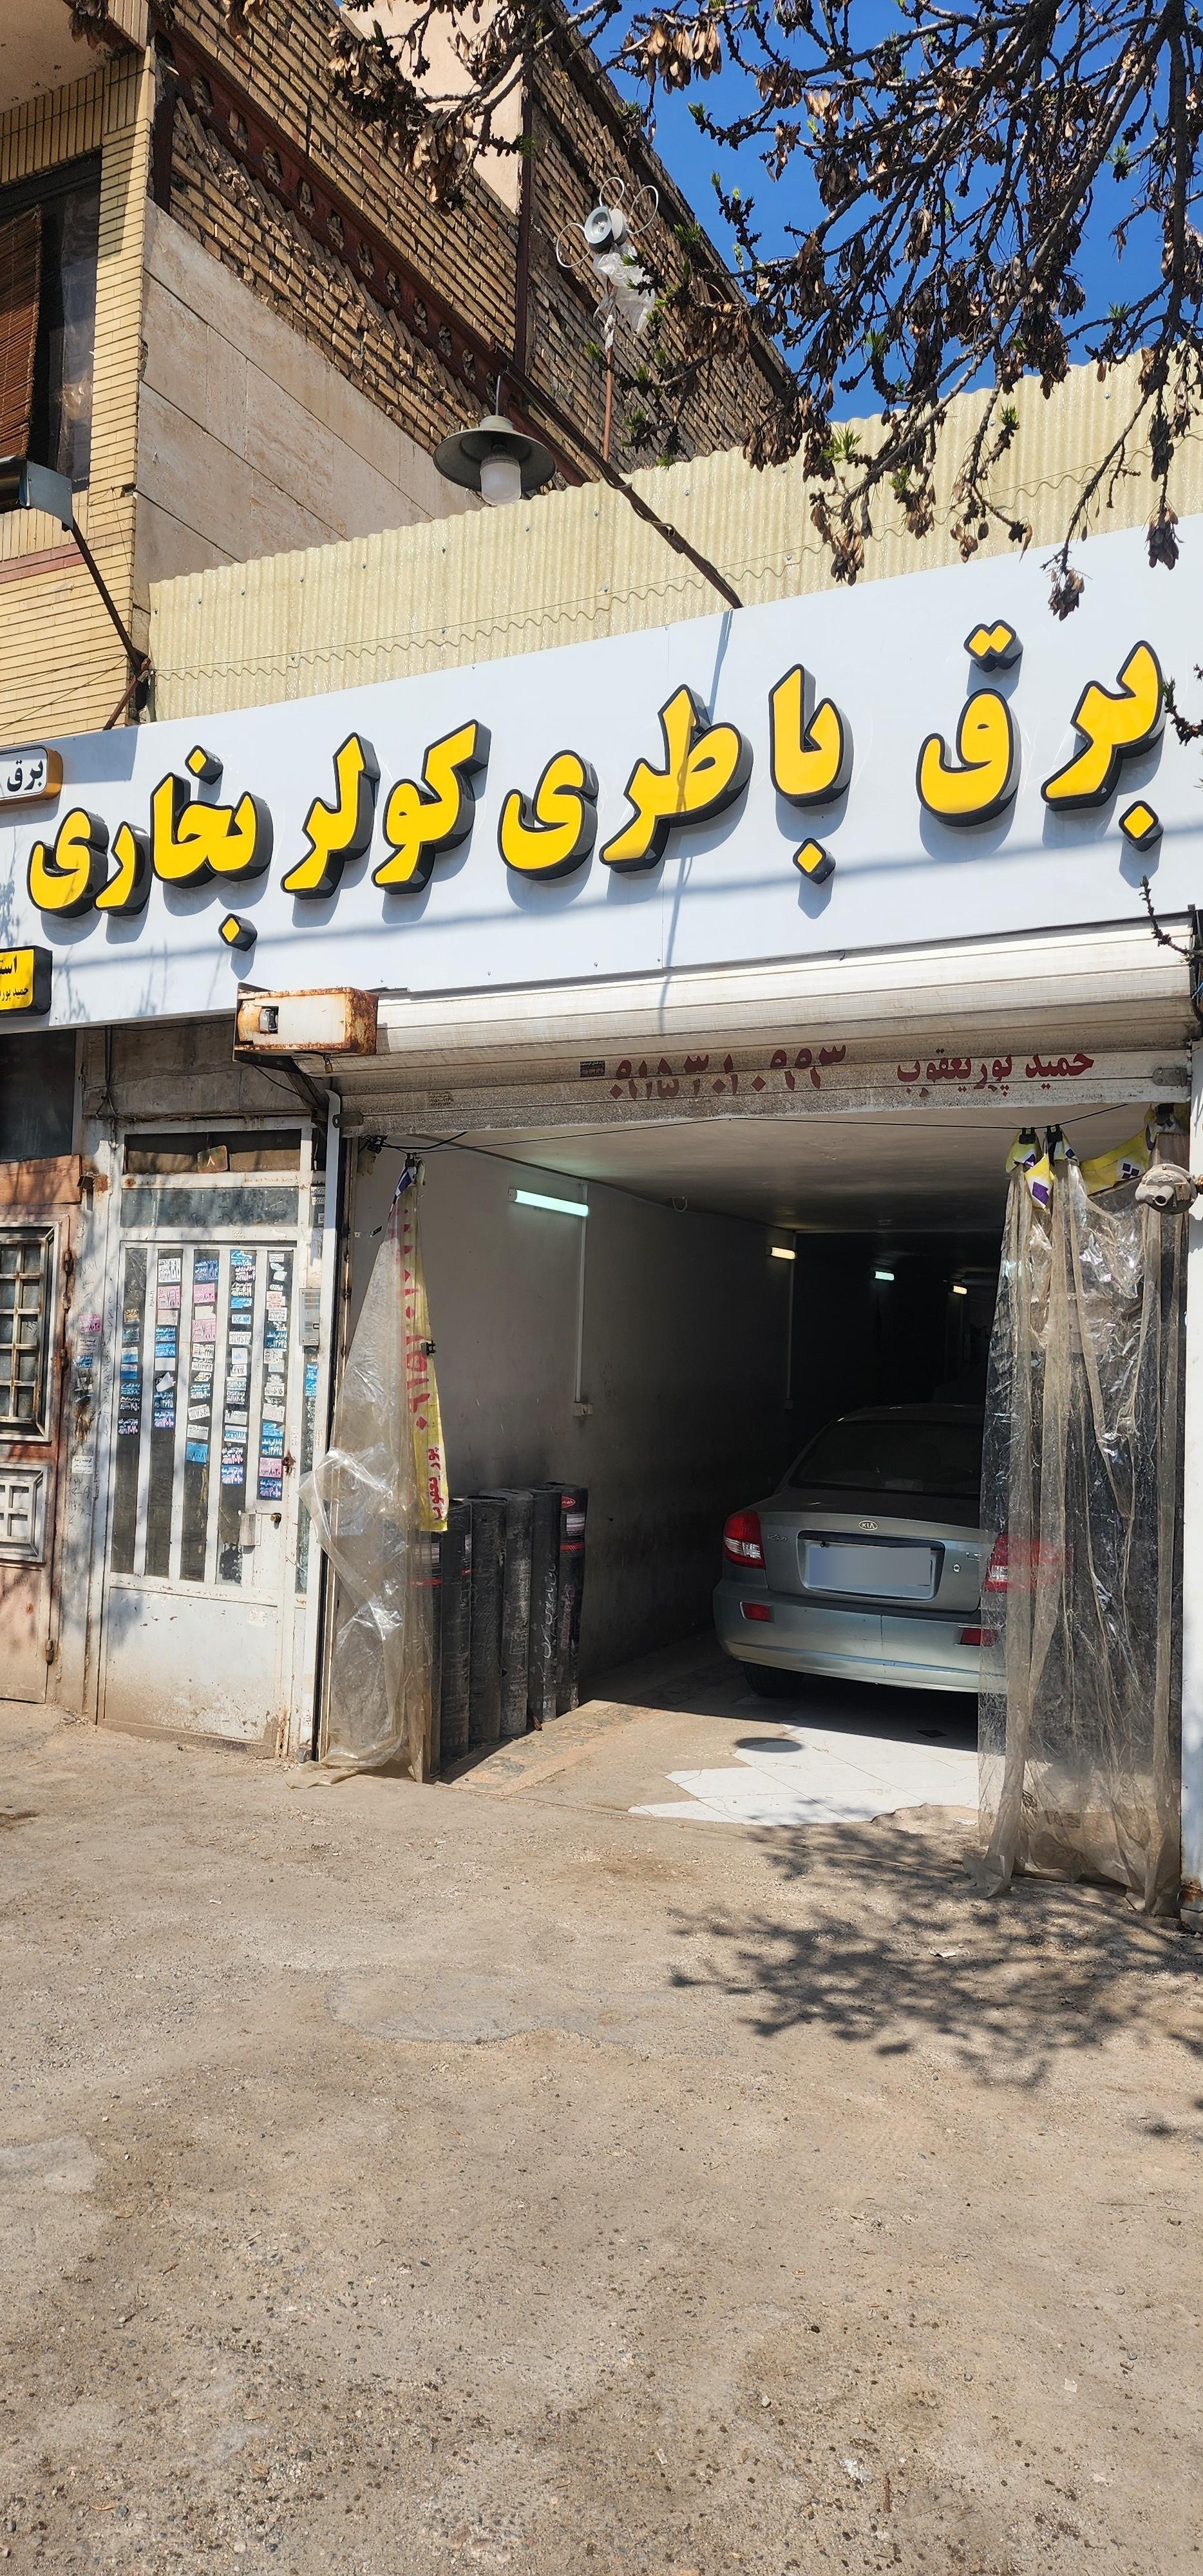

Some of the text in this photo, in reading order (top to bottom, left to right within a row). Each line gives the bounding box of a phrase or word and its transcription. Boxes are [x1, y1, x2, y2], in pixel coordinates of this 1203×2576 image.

[6, 759, 44, 792] برق
[26, 618, 1165, 952] برق باطری کولر بخاری
[13, 987, 29, 999] حمید
[1025, 1053, 1095, 1090] حمید
